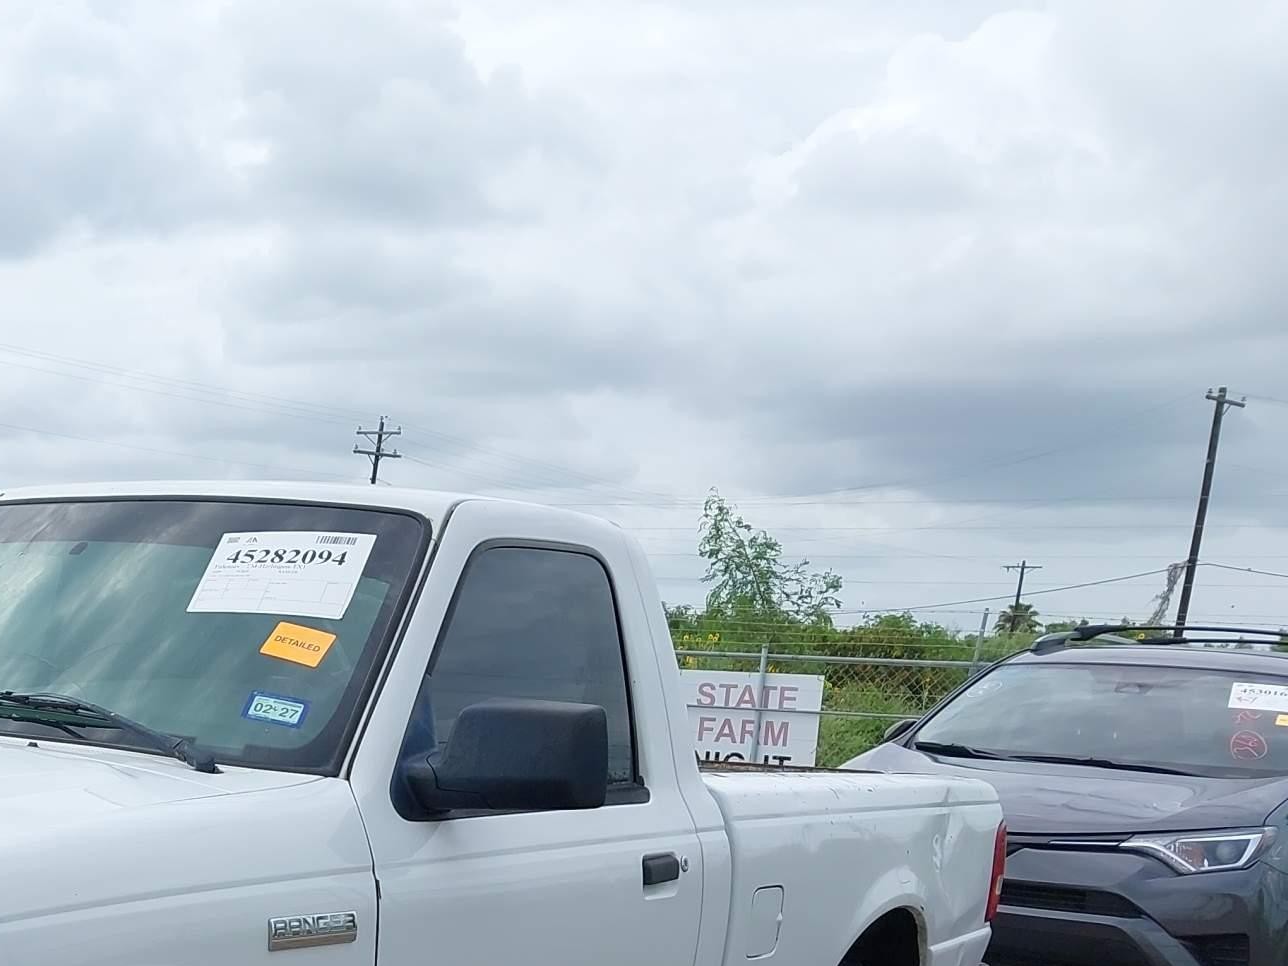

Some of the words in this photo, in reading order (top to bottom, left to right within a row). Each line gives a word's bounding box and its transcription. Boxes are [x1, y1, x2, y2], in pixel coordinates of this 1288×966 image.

[226, 548, 348, 566] 45282094
[274, 635, 321, 653] DETAILED
[696, 682, 799, 711] STATE
[697, 717, 790, 747] FARM
